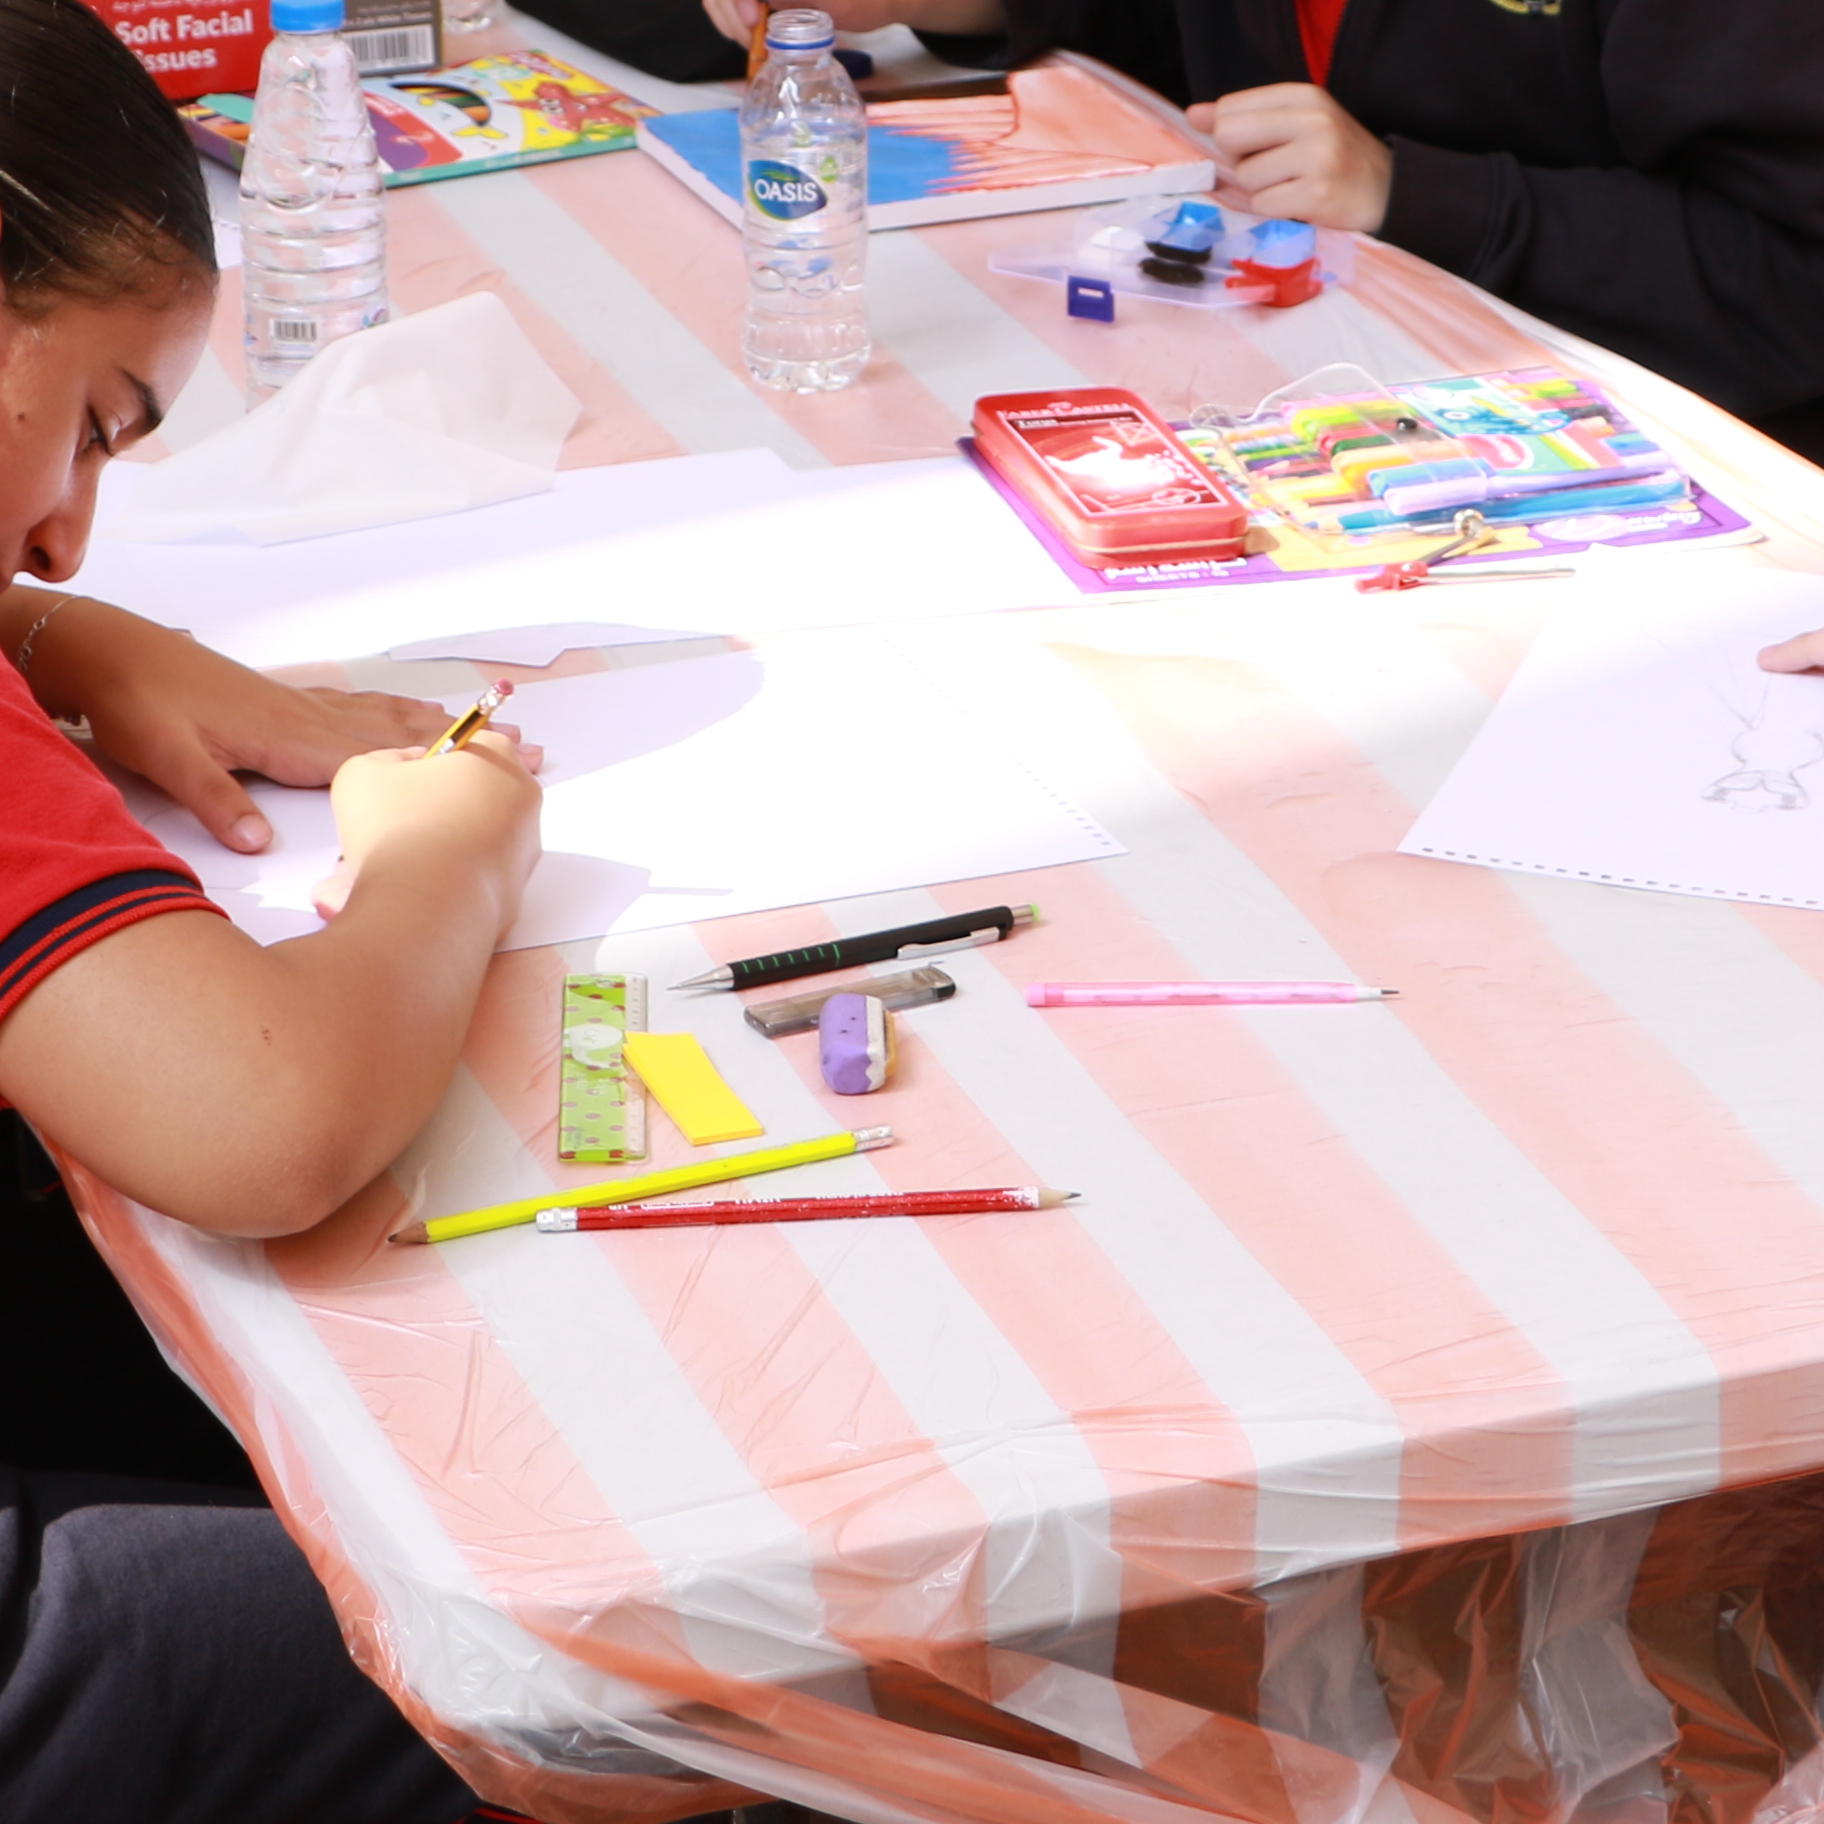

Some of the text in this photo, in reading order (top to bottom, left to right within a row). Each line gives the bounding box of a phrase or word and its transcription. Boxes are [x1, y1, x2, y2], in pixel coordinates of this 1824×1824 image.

[115, 9, 254, 45] Soft Facial
[754, 178, 819, 203] OASIS
